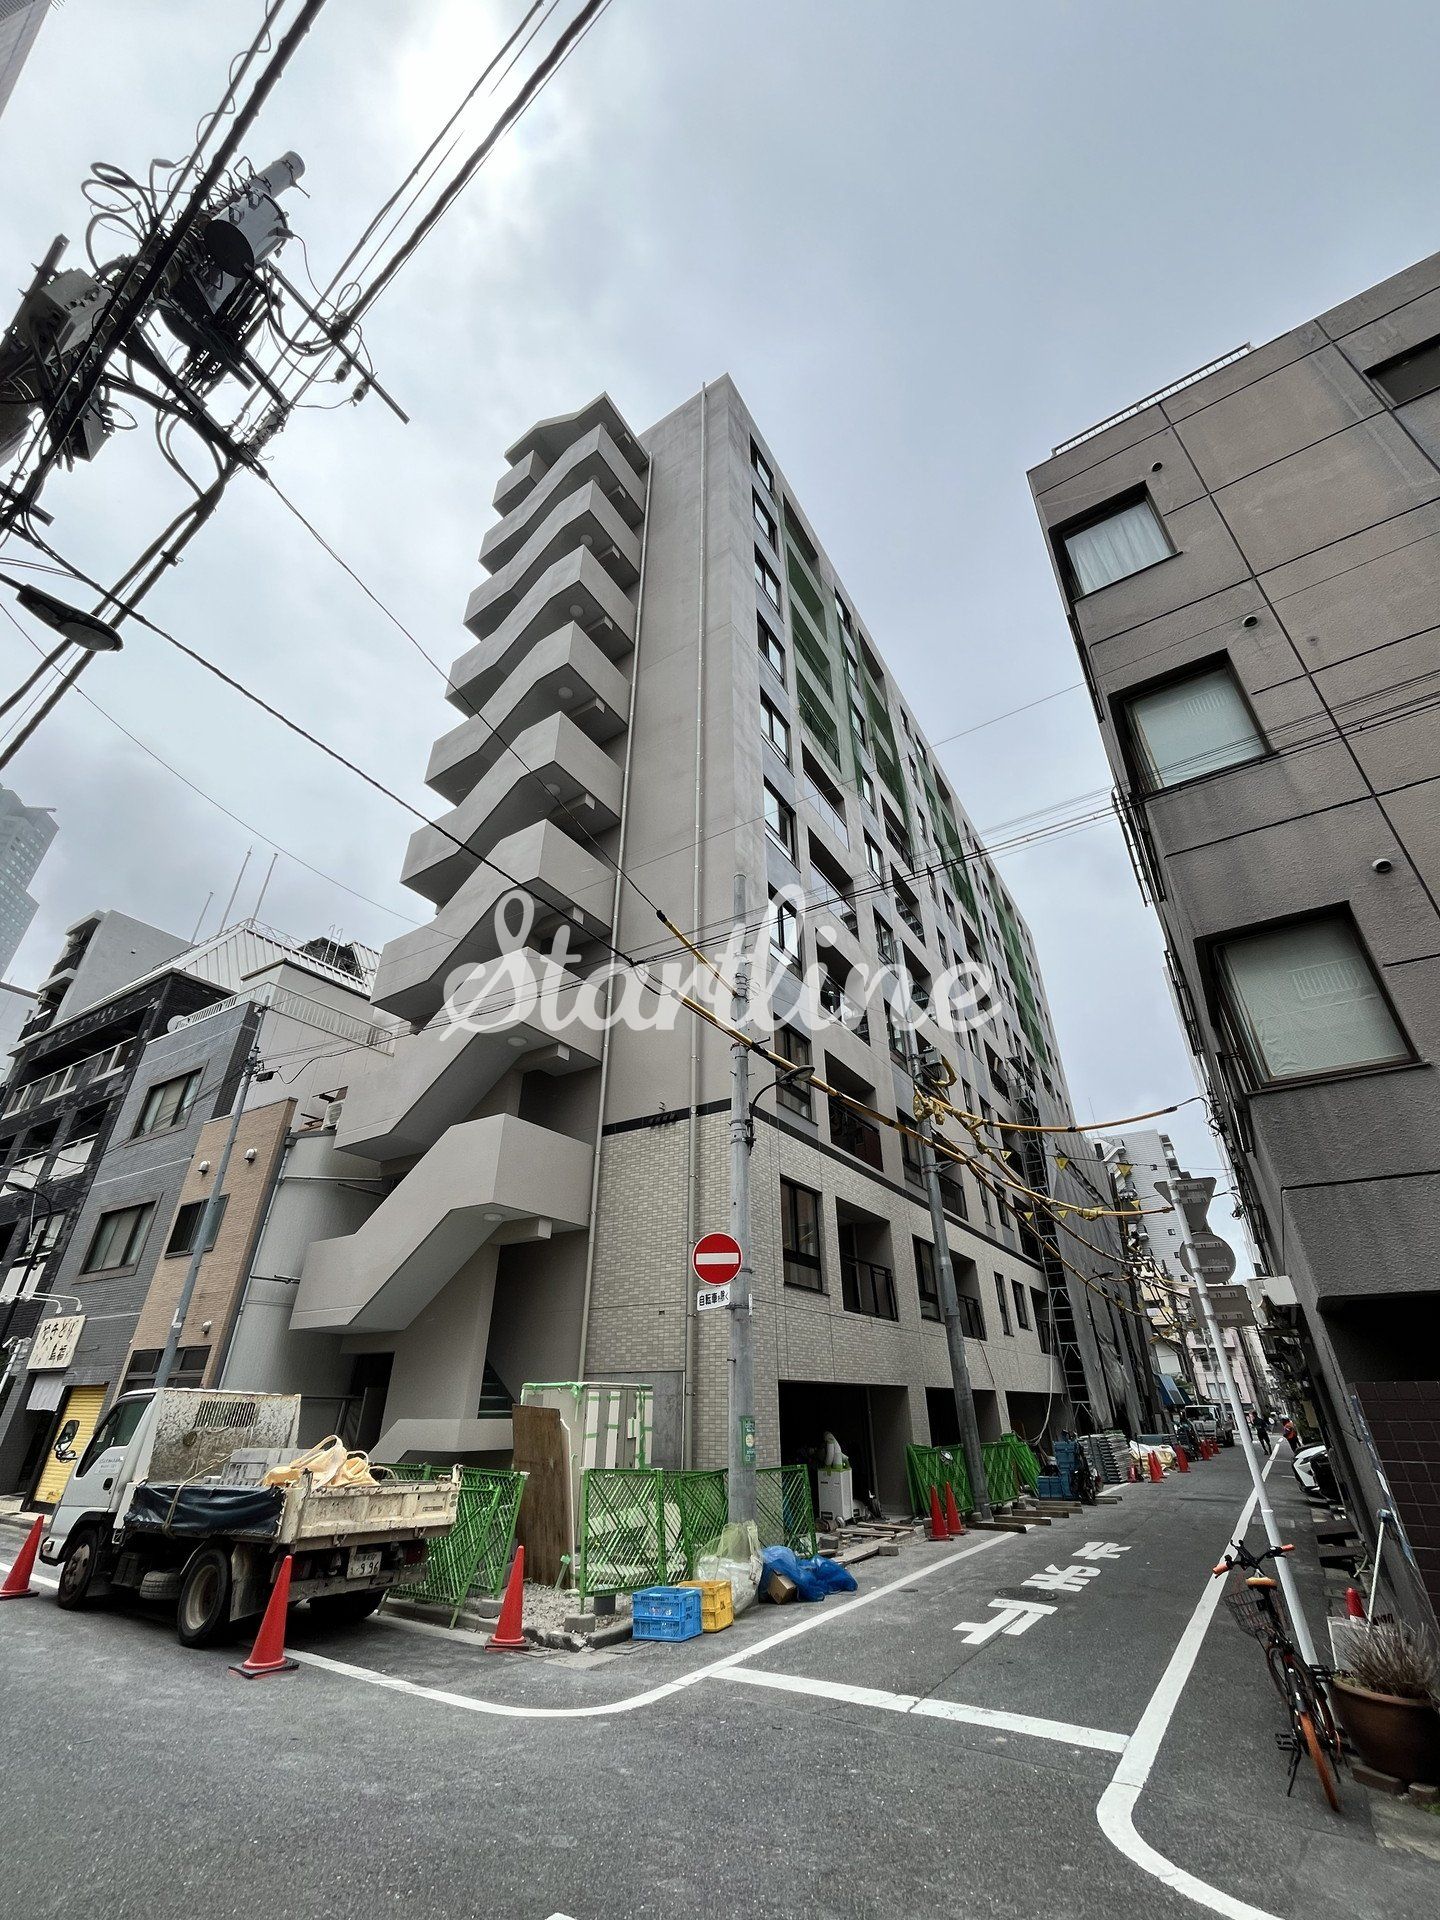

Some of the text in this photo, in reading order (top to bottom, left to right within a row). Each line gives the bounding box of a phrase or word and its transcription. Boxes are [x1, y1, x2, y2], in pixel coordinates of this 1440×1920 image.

[699, 1290, 729, 1307] 自転車を除く
[953, 1541, 1132, 1645] 止まれ
